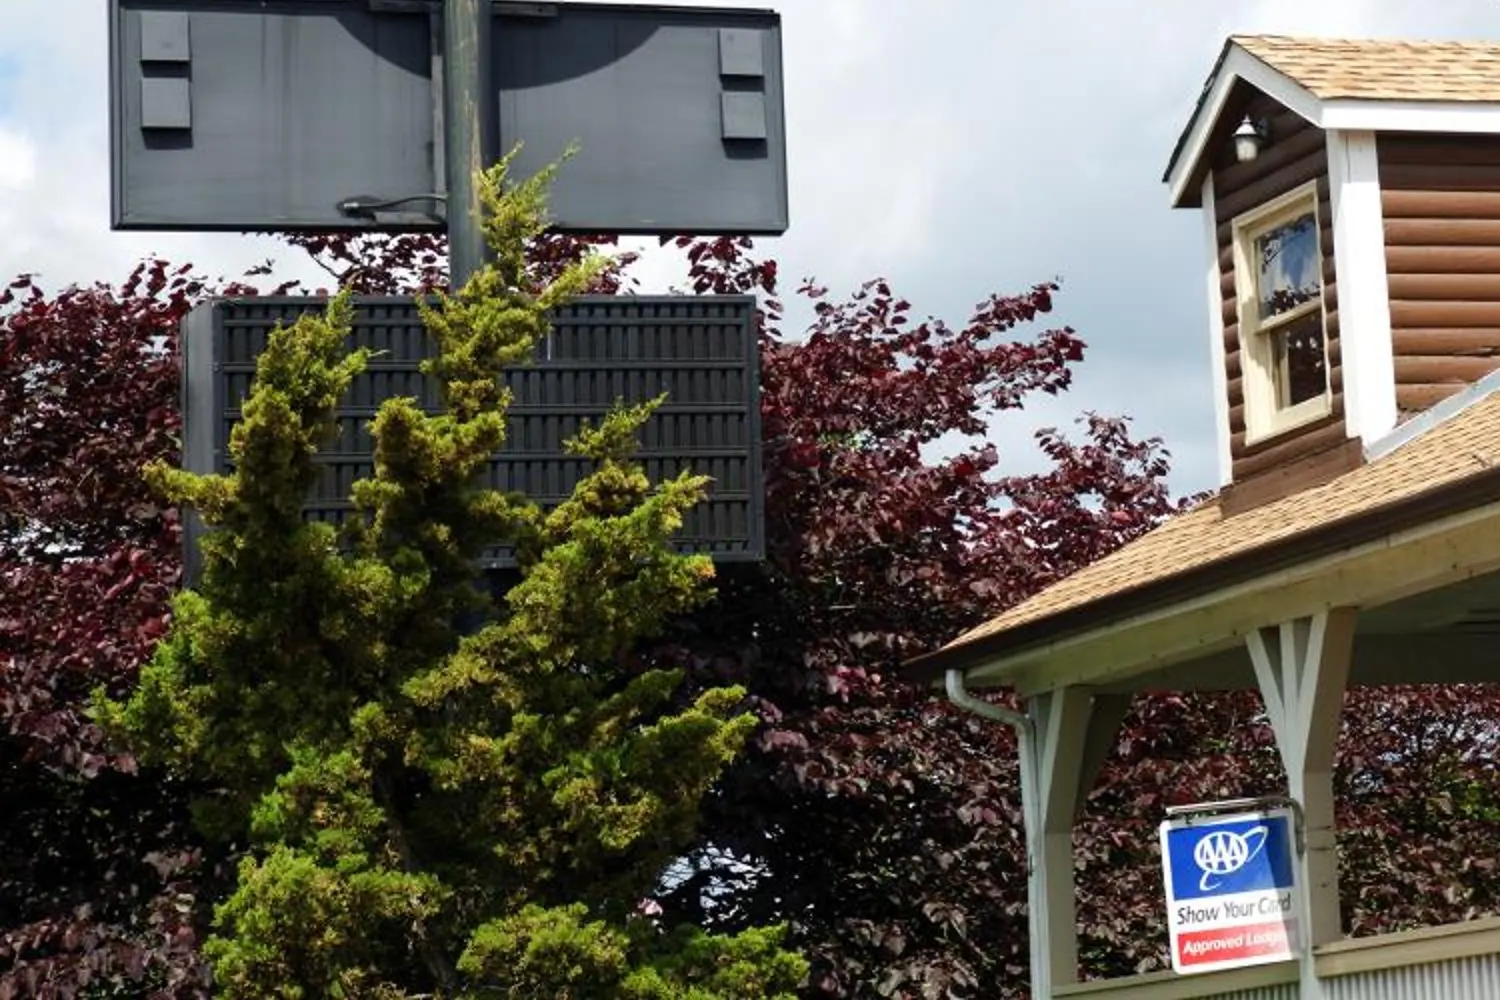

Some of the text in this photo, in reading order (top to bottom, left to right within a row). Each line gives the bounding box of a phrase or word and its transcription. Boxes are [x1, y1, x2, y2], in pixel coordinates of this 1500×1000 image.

[1198, 832, 1245, 874] AAA
[1176, 905, 1220, 925] Show
[1223, 900, 1255, 919] Your
[1183, 934, 1243, 957] Approved
